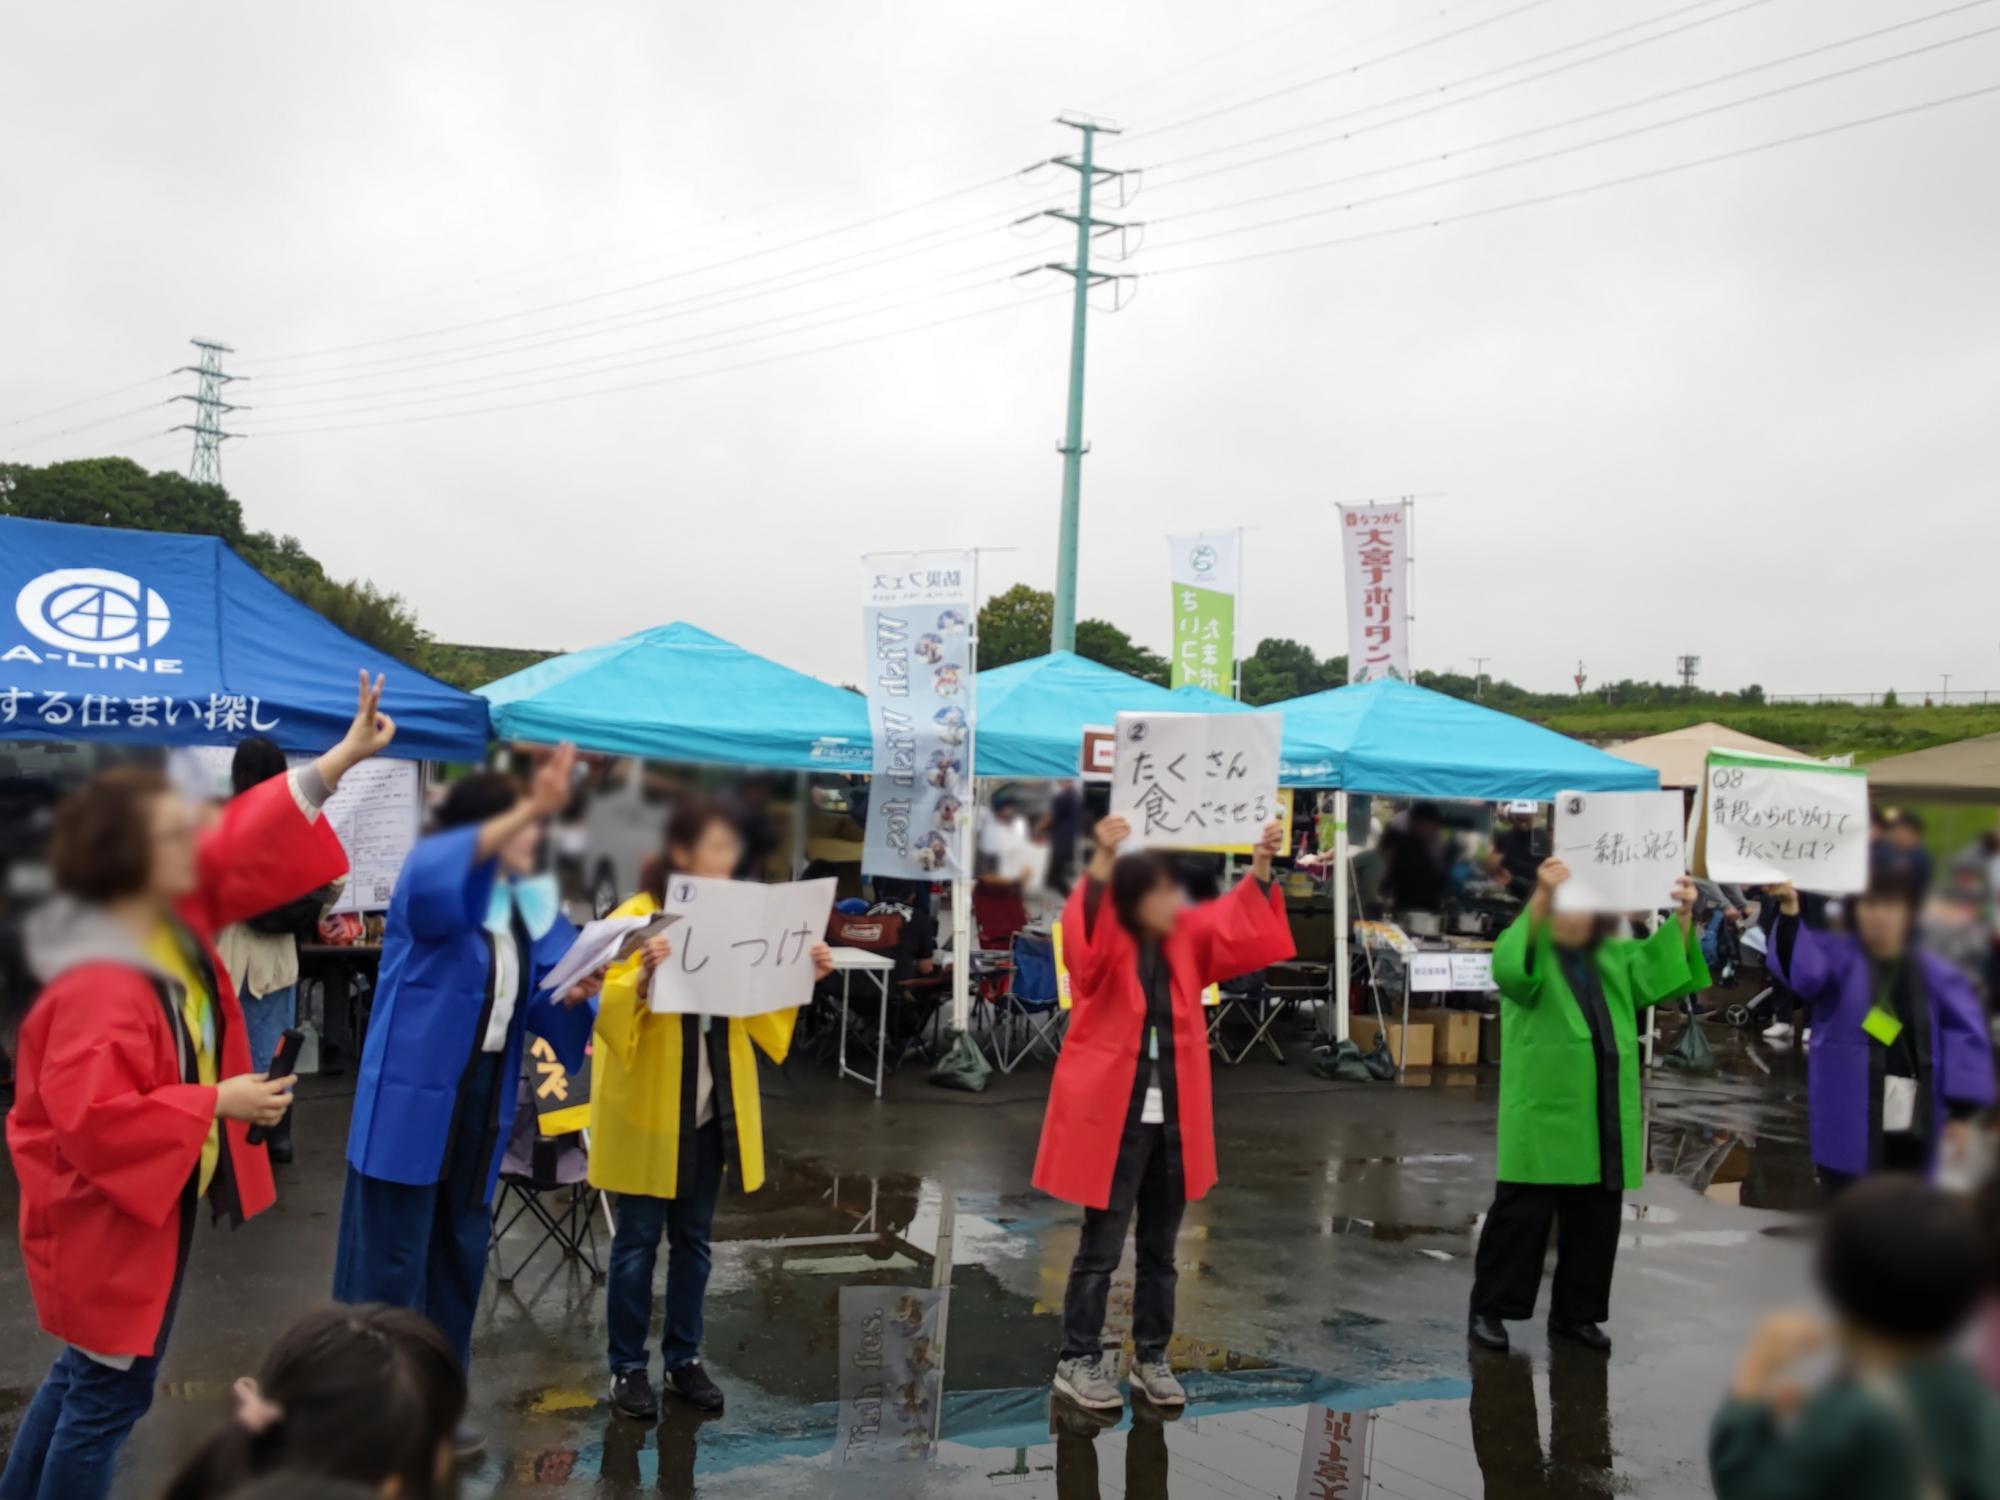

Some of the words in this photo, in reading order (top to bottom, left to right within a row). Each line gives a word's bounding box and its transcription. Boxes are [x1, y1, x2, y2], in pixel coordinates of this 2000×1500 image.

[0, 645, 183, 674] A-LINE
[0, 686, 280, 732] する住まい探し
[1132, 751, 1248, 785] たくさん
[1712, 768, 1744, 788] Q8
[1133, 783, 1269, 836] 食べさせる
[1564, 828, 1678, 865] 一緒に寝る
[681, 920, 813, 975] しつけ
